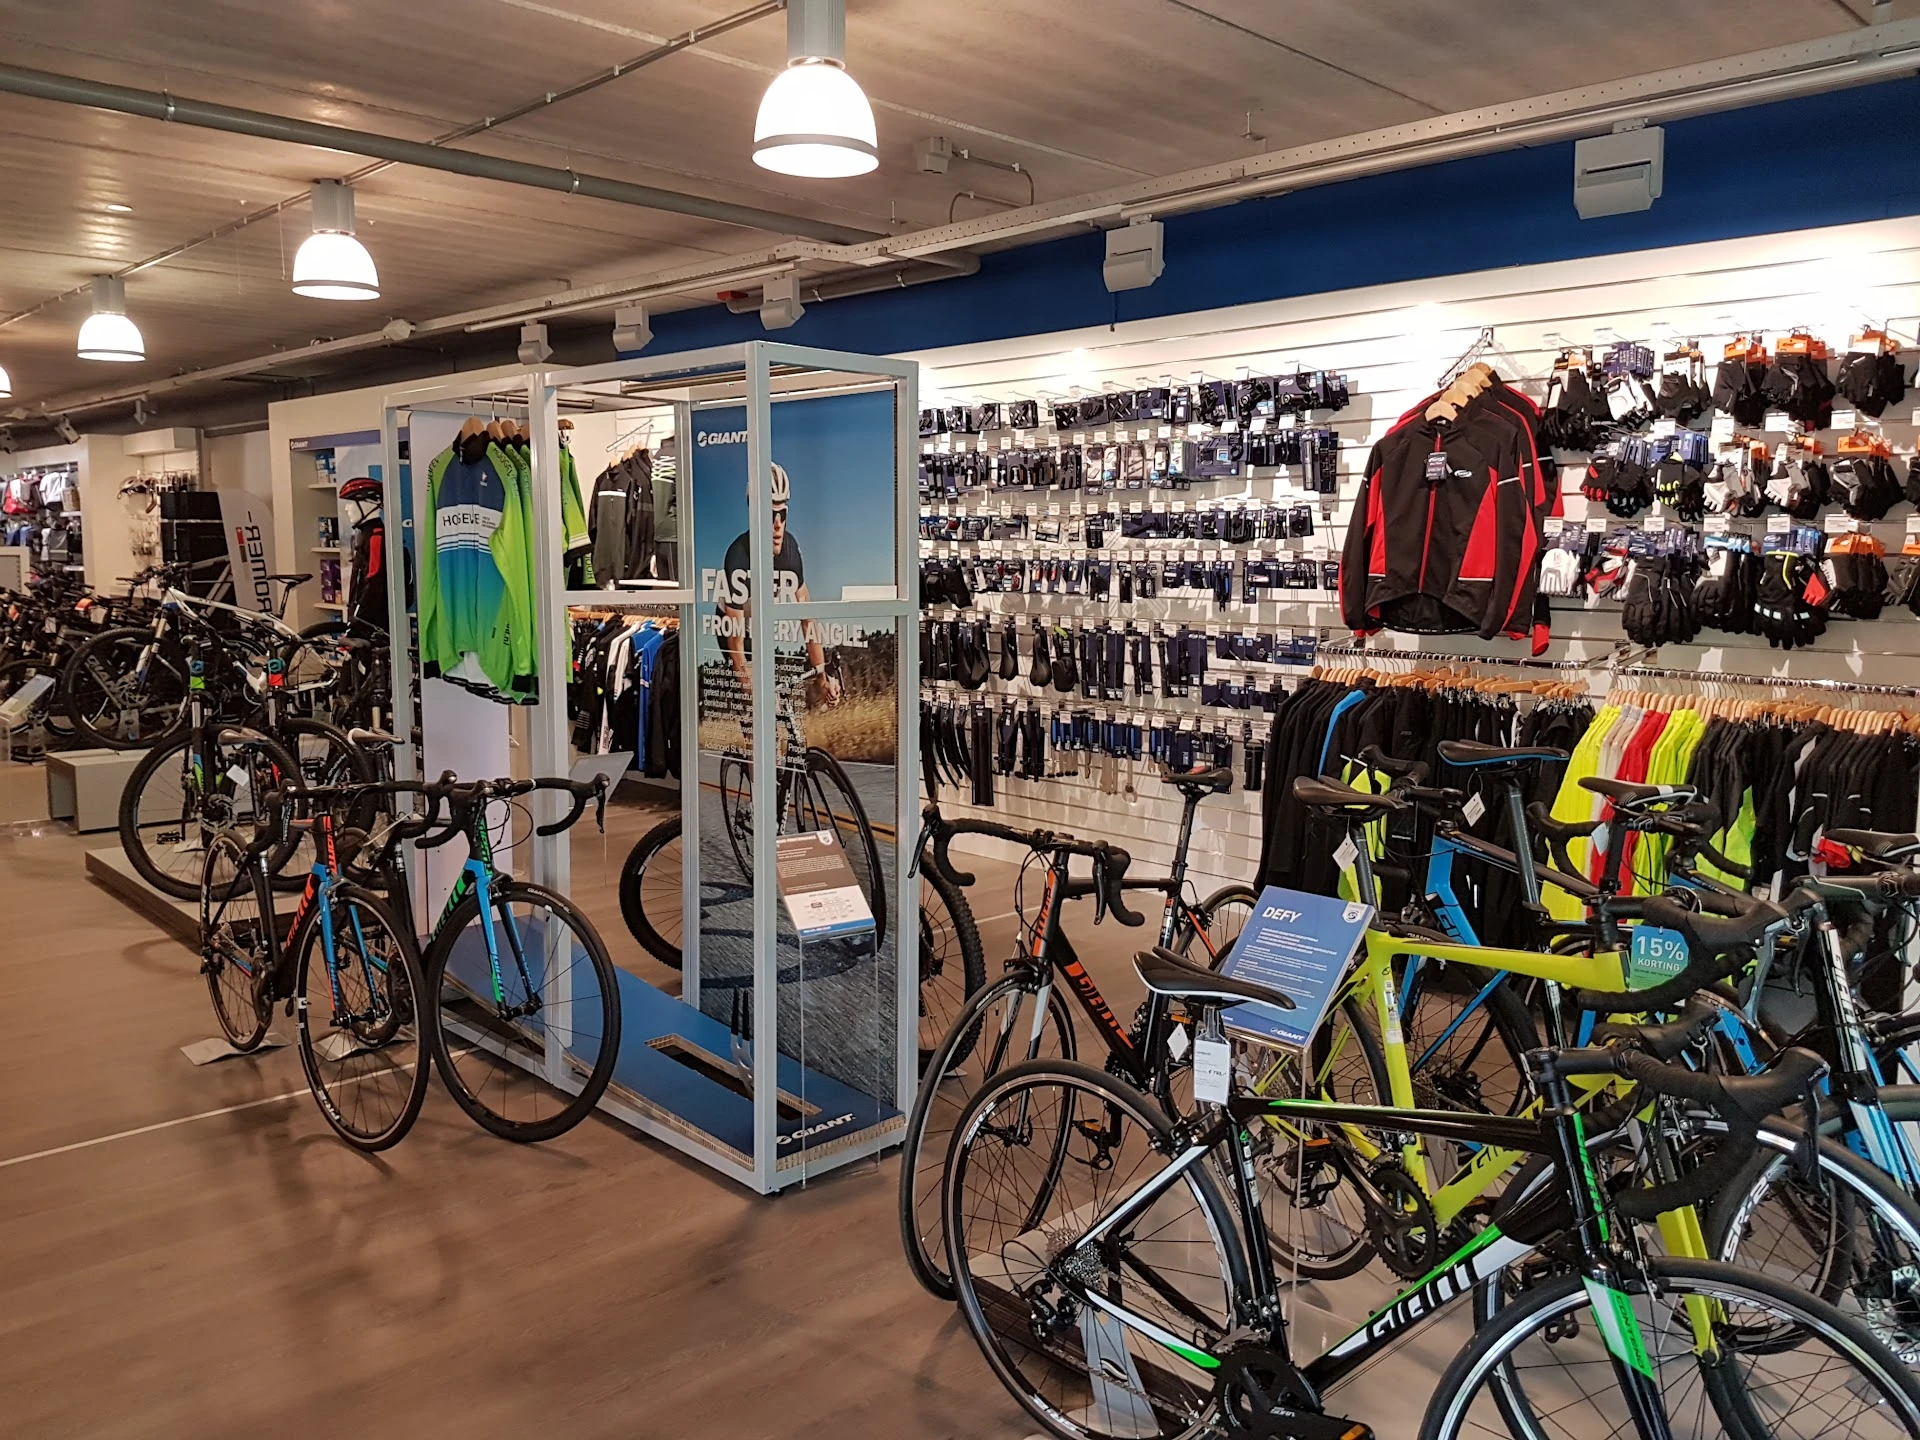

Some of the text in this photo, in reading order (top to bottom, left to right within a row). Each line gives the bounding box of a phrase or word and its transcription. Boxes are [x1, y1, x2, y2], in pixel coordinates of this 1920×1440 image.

[708, 430, 748, 445] GIANT
[702, 568, 800, 603] FASER
[703, 614, 746, 638] FROM
[805, 621, 868, 649] ANGLE.
[1262, 906, 1302, 923] DEFY
[1636, 935, 1684, 961] 15%
[1637, 957, 1680, 971] KORTING
[1276, 1029, 1305, 1041] GIANT
[791, 1112, 856, 1140] GIANT
